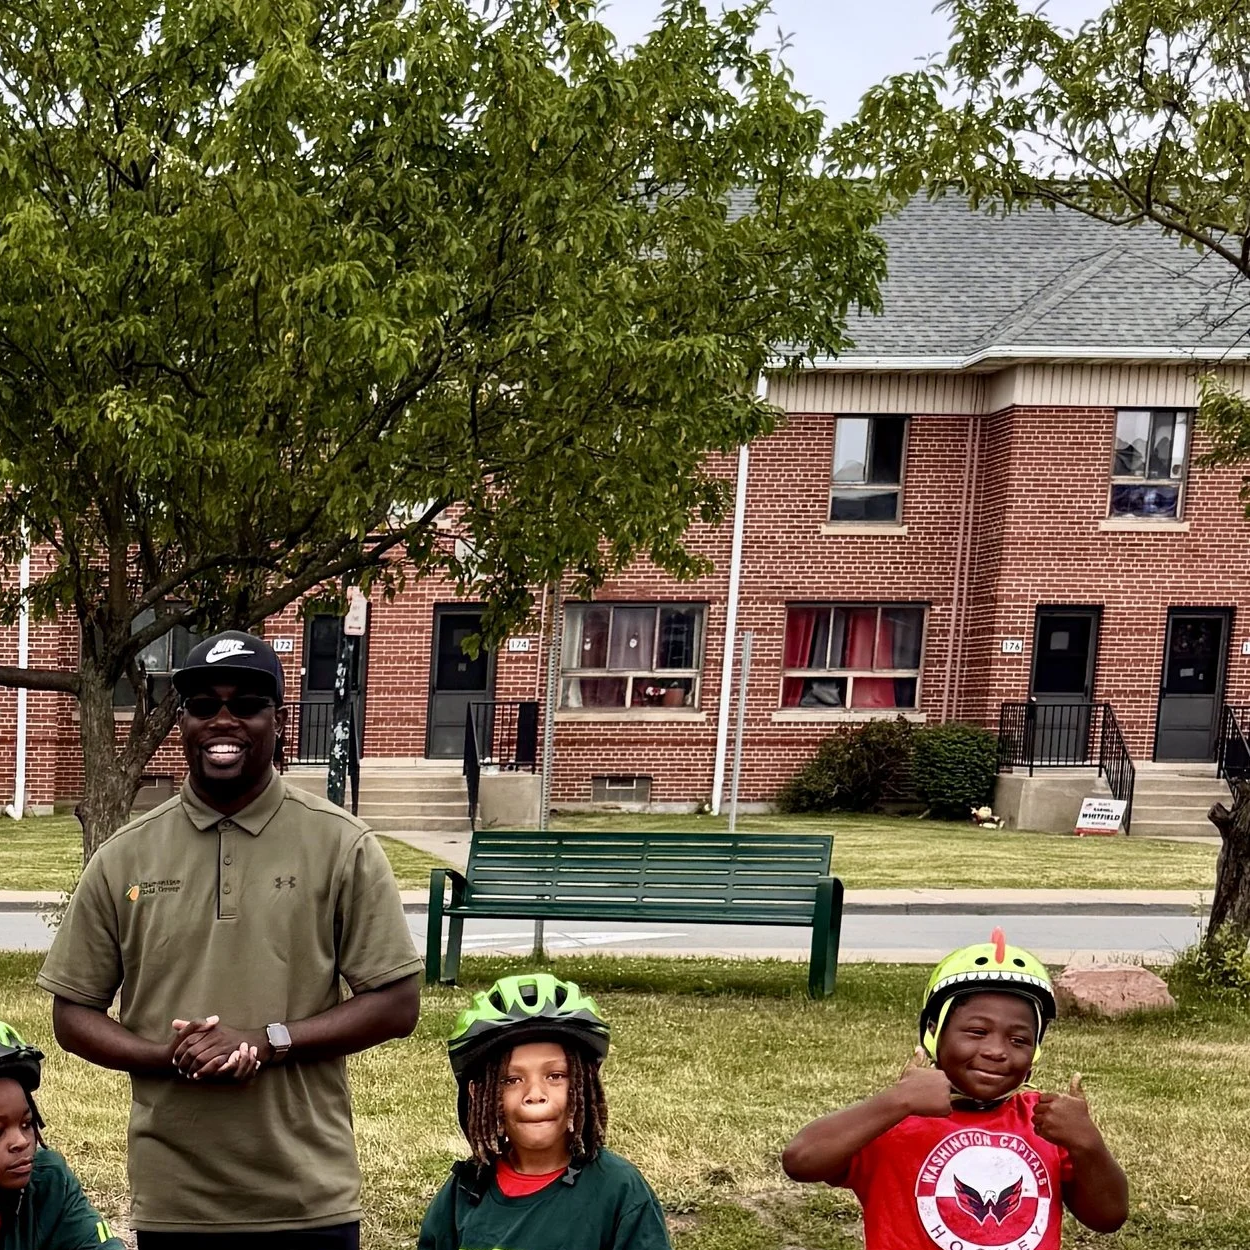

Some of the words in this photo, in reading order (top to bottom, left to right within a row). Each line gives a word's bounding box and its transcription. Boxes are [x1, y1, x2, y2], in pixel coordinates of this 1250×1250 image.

[212, 639, 245, 655] NIKE
[275, 641, 291, 650] 172
[510, 640, 528, 649] 174
[1004, 642, 1021, 651] 176
[921, 1132, 992, 1184] WASHINGTON
